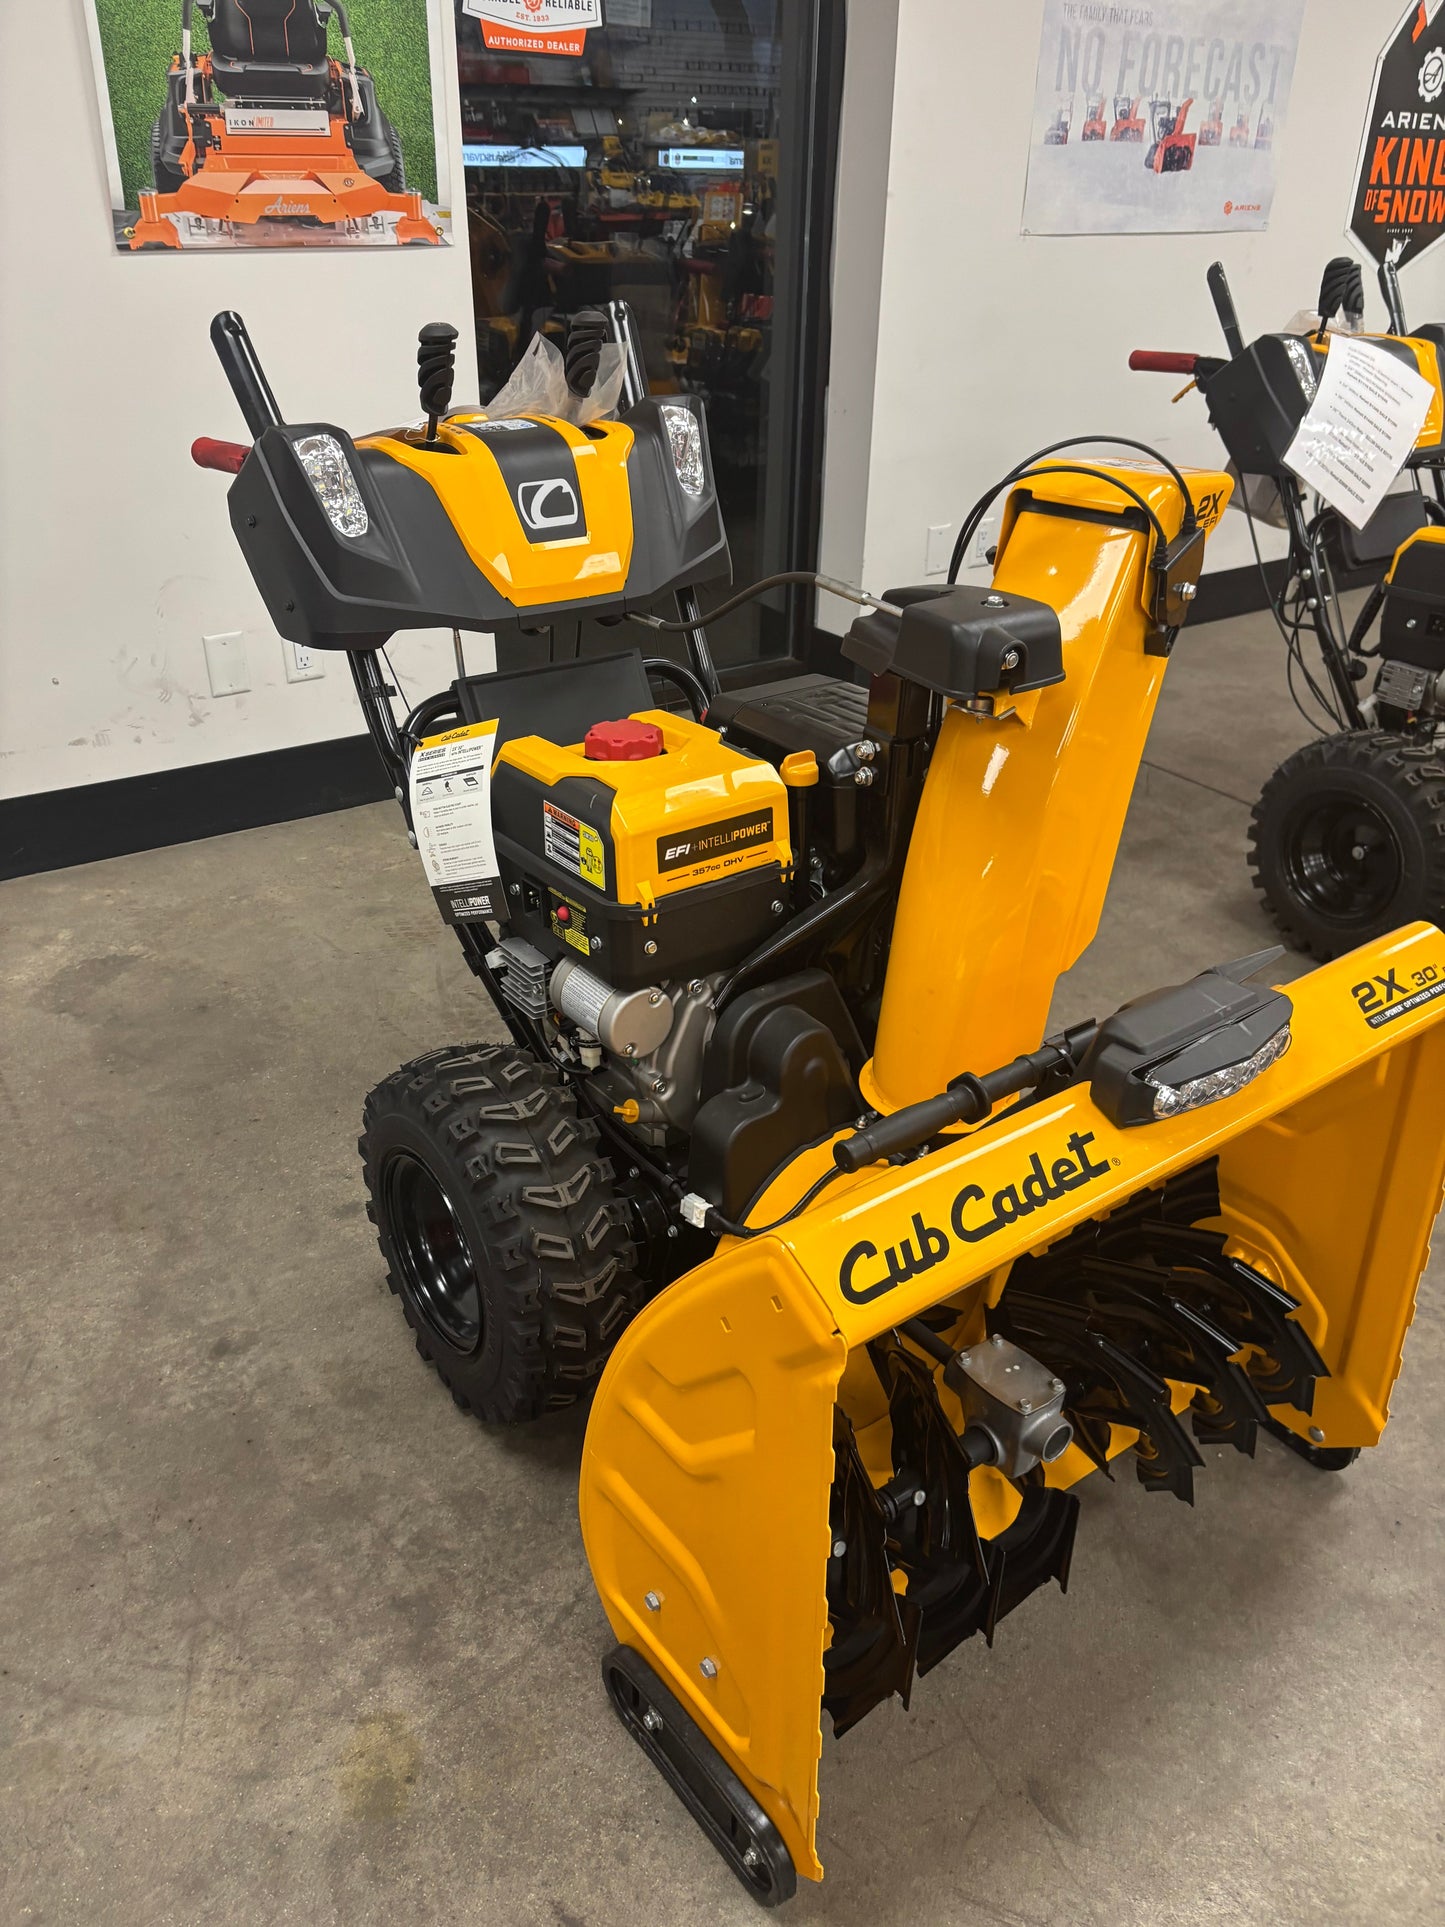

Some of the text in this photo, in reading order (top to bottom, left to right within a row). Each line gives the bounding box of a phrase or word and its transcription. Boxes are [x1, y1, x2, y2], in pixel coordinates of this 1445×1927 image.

[516, 12, 531, 21] EST.
[488, 36, 580, 52] AUTHORIZED DEALER
[1055, 25, 1288, 104] NO FORECAST
[264, 195, 311, 214] Ariens
[1364, 189, 1377, 211] OF
[1197, 490, 1224, 520] 2X
[664, 843, 691, 861] EFI
[692, 856, 744, 877] 357cc OHV
[450, 895, 491, 909] INTELLIPOWER
[1351, 967, 1410, 1015] 2X
[839, 1212, 950, 1305] Cub
